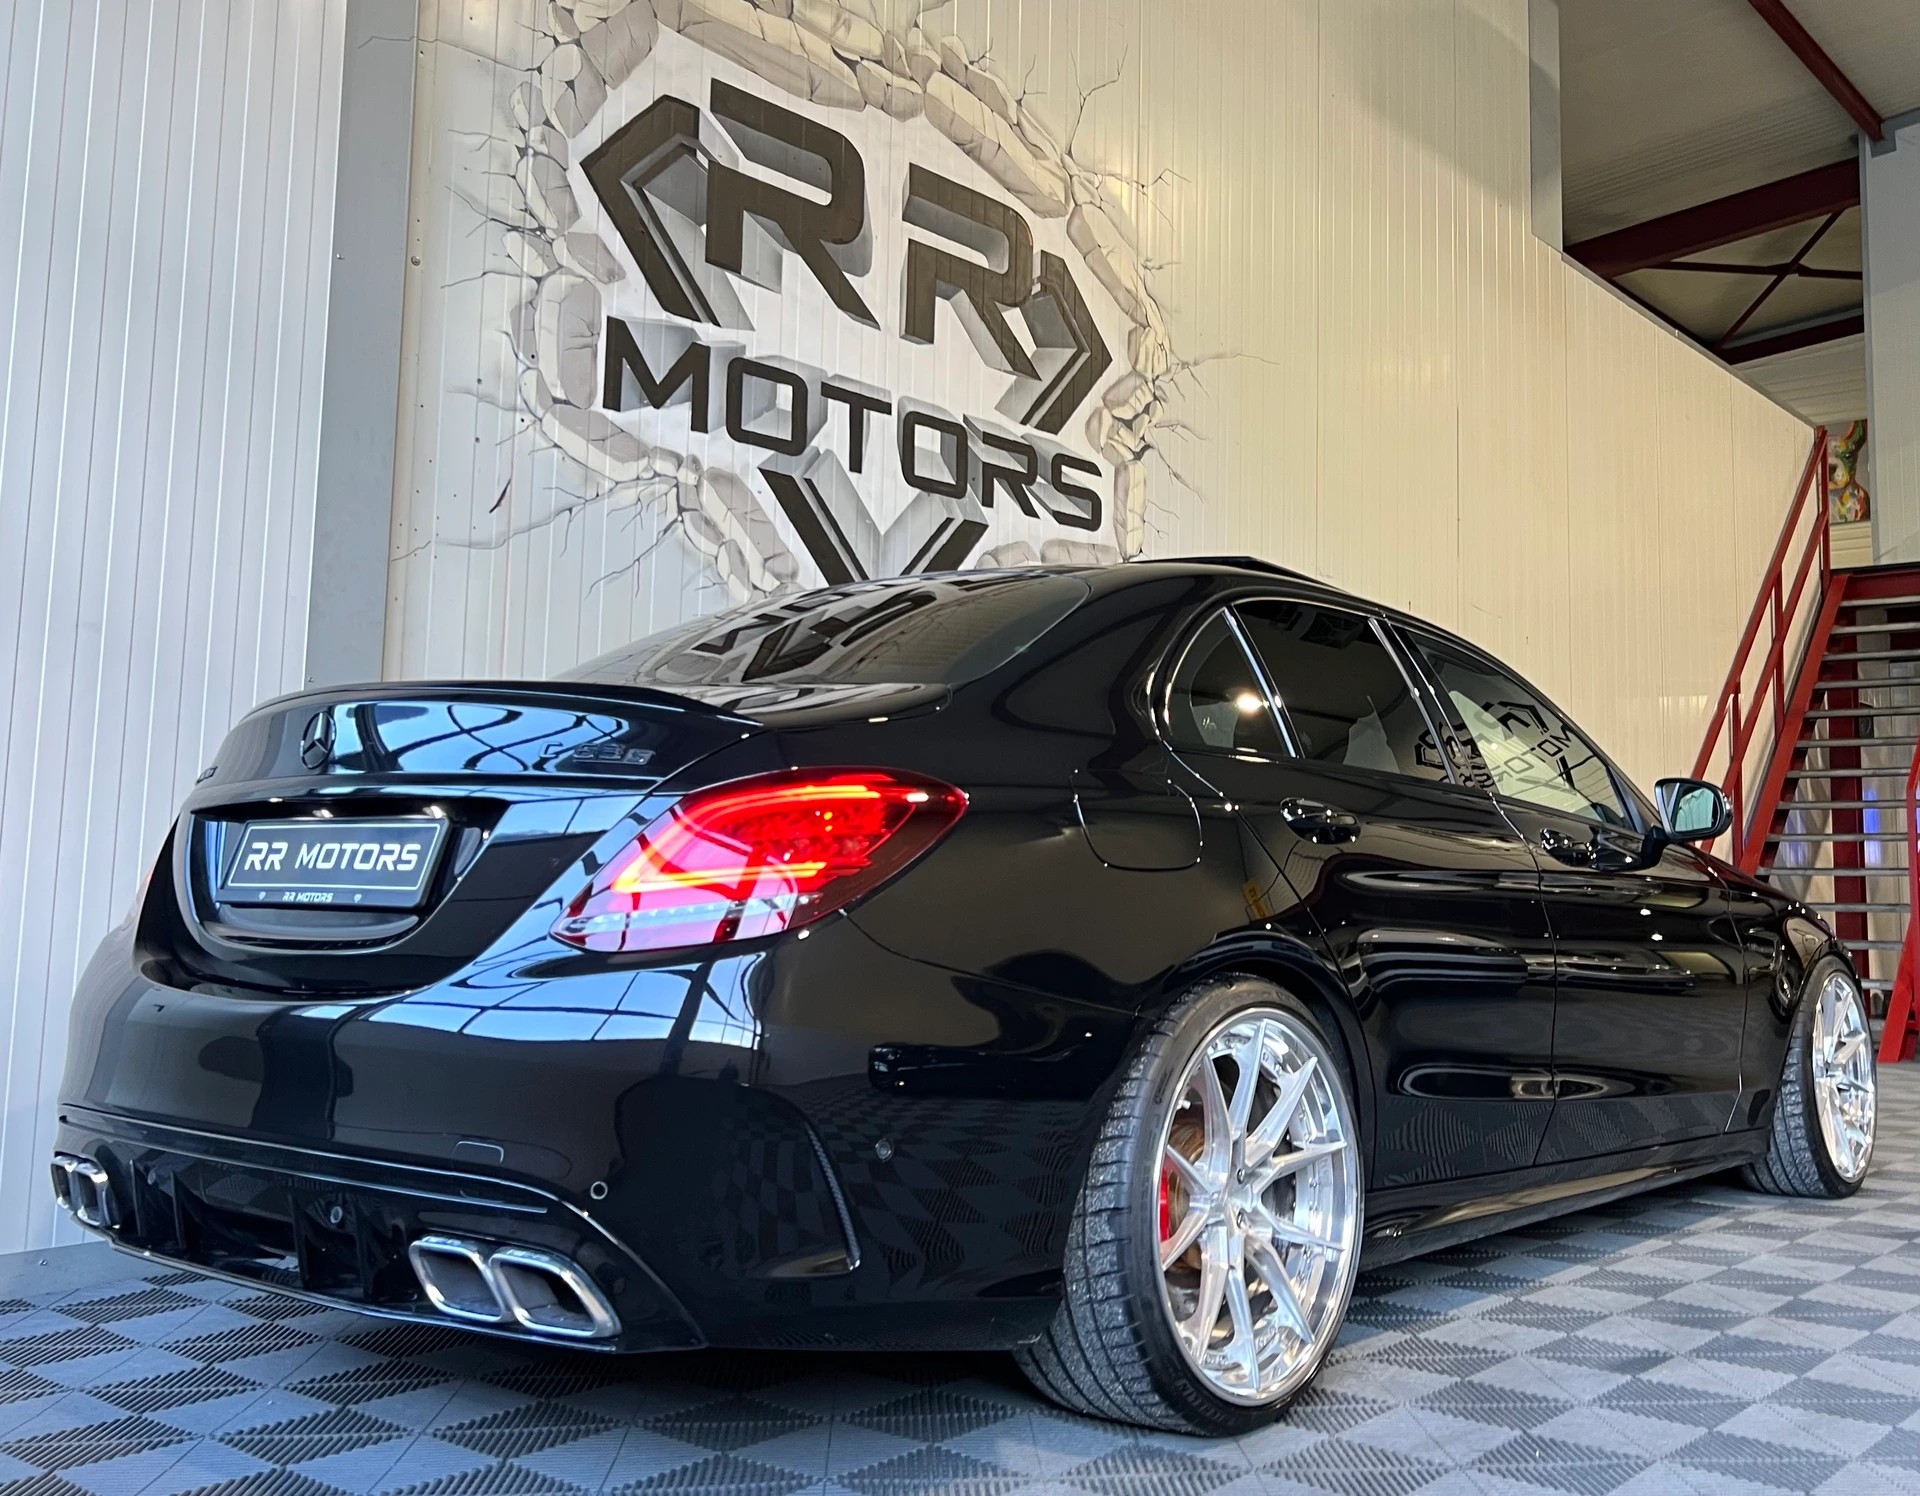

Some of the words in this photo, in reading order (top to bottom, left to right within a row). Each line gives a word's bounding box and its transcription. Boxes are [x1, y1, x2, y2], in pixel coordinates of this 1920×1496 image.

[704, 78, 1043, 382] RR
[602, 315, 1103, 533] MOTORS
[244, 842, 288, 871] RR
[294, 843, 421, 871] MOTORS
[282, 891, 297, 902] RR
[296, 892, 334, 903] MOTORS
